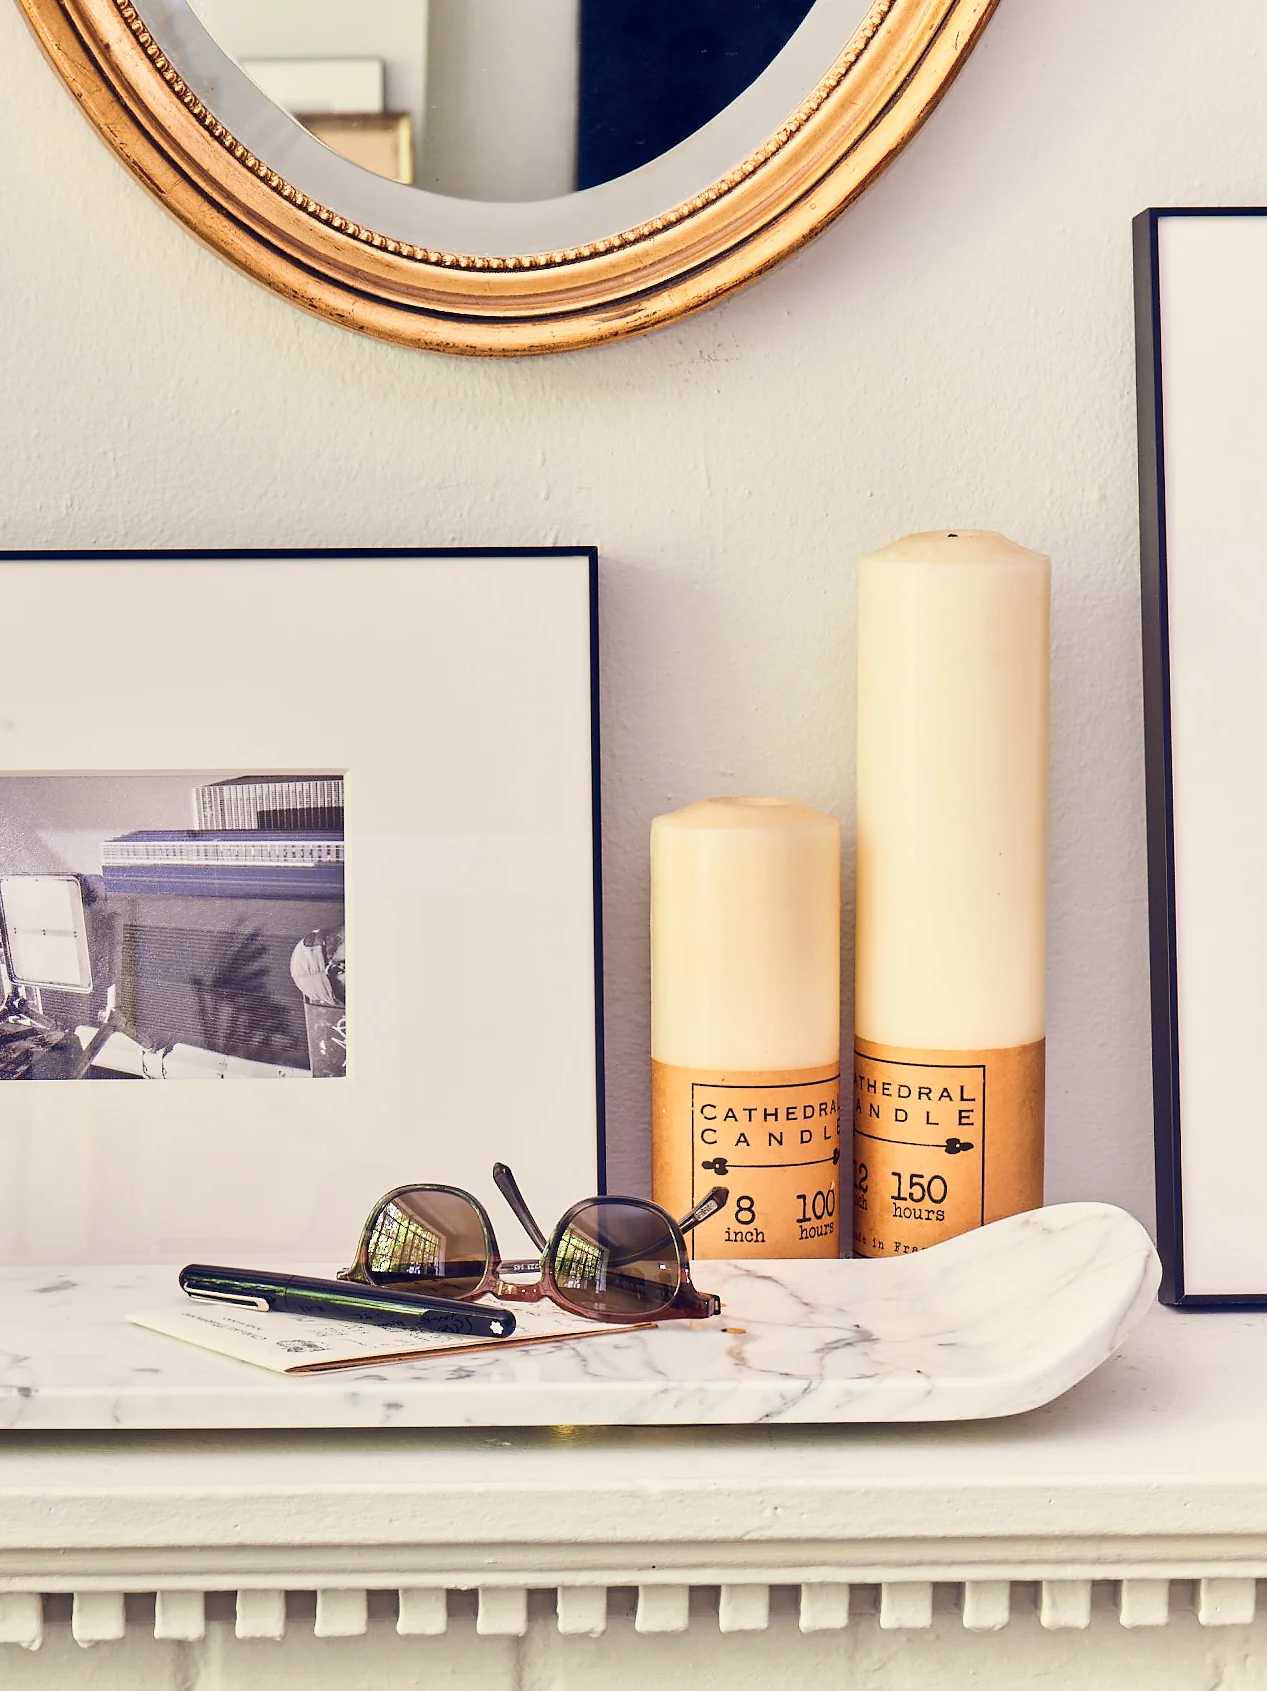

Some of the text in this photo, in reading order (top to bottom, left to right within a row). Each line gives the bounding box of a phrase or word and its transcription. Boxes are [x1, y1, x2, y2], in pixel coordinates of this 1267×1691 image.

[854, 1072, 976, 1103] ATHEDRAL
[854, 1098, 975, 1127] ANDLE
[890, 1171, 948, 1205] 150
[734, 1195, 756, 1226] 8
[796, 1189, 836, 1223] 100
[892, 1202, 945, 1222] hours
[724, 1222, 835, 1244] inch hours
[872, 1236, 884, 1250] in
[893, 1241, 926, 1254] Fra
